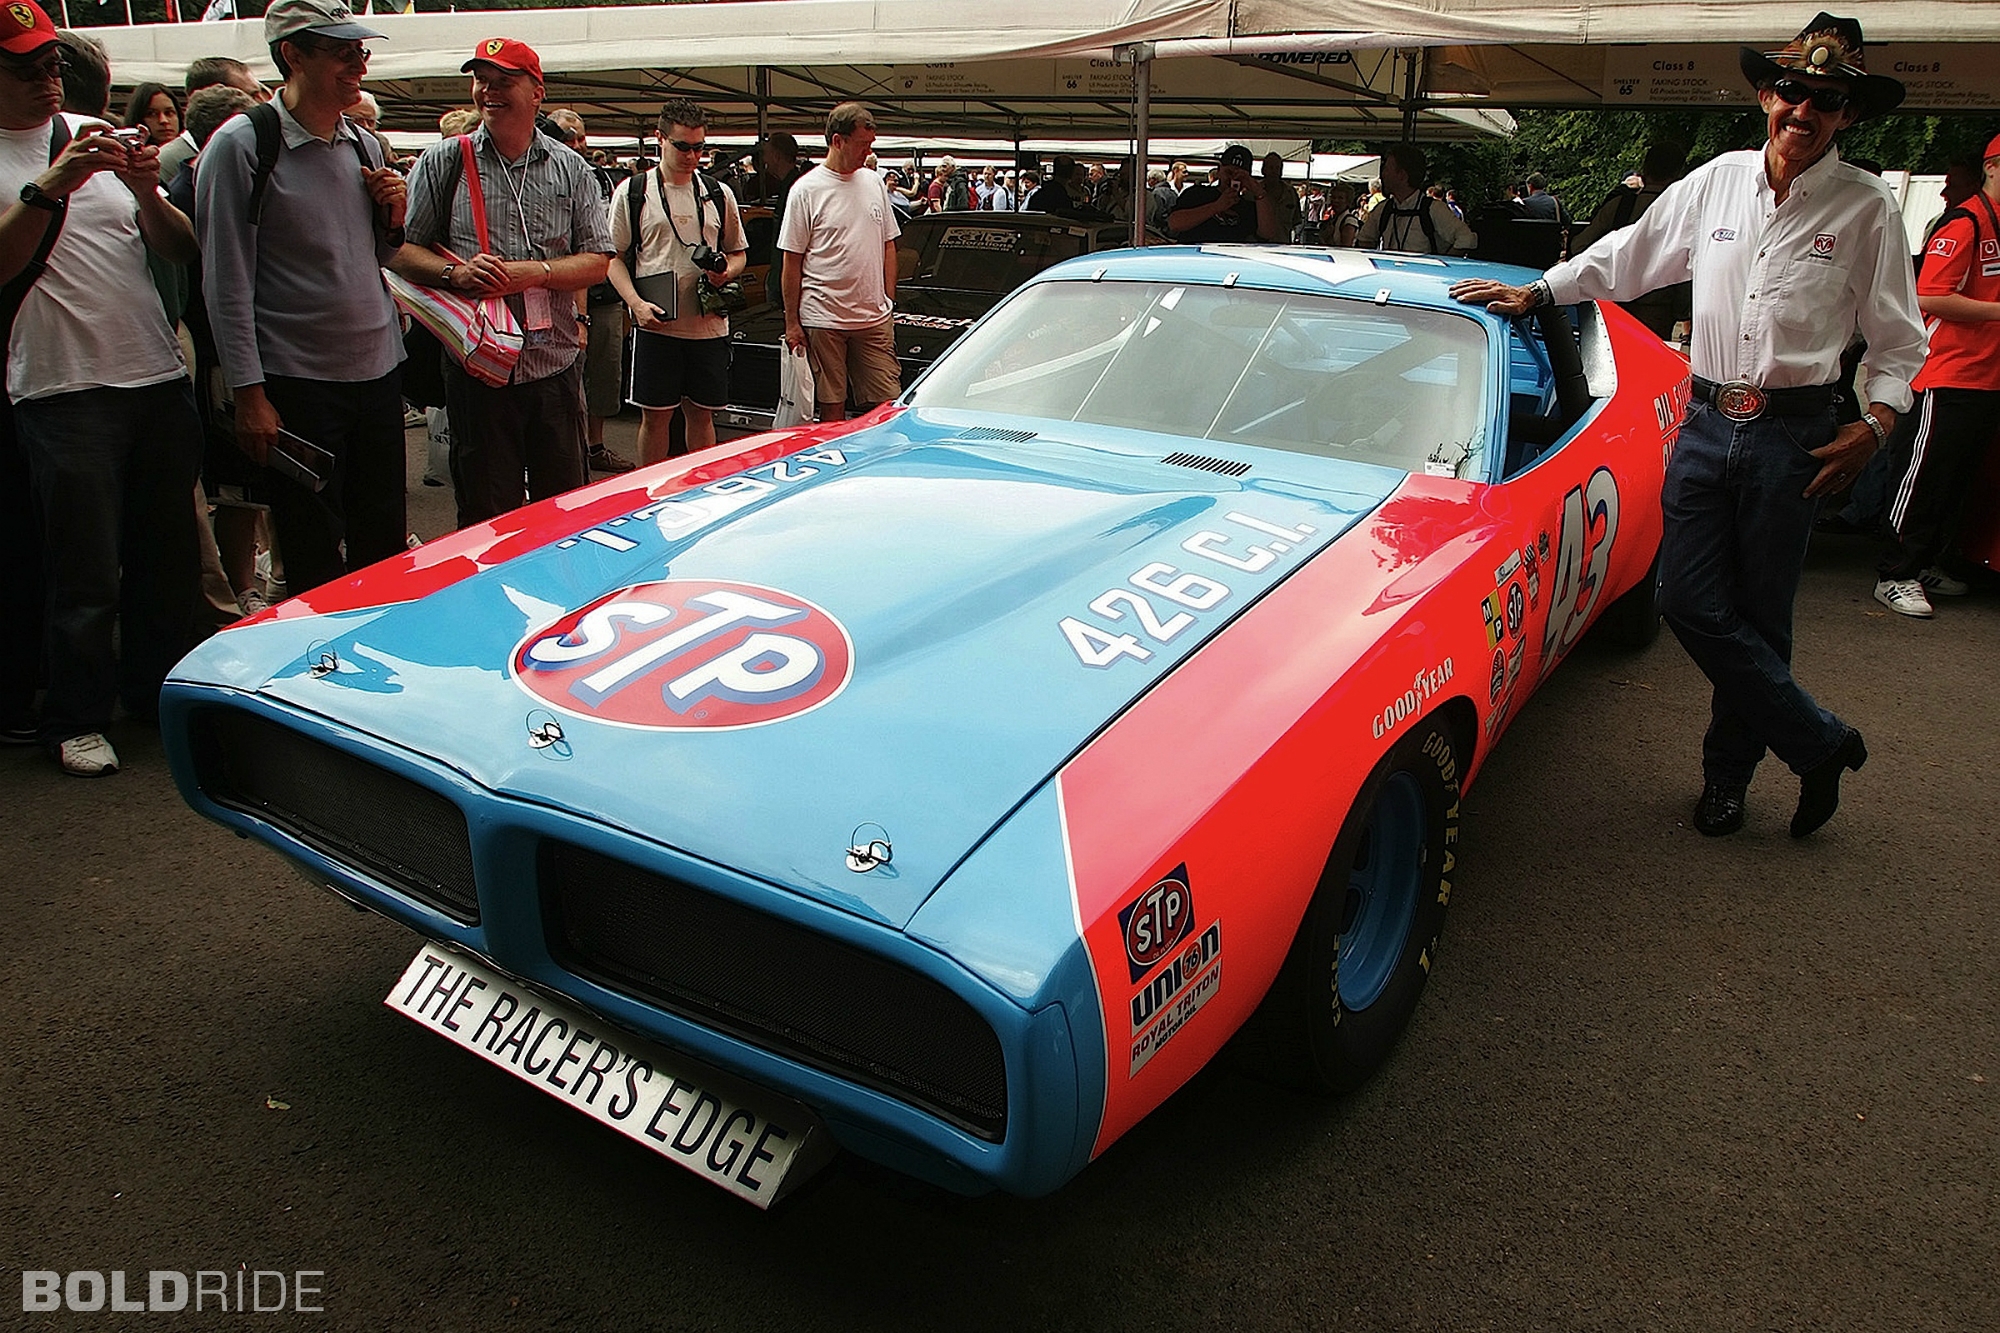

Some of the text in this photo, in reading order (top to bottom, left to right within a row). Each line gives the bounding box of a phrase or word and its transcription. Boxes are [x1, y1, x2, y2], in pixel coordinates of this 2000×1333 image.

[1089, 58, 1114, 68] Class
[1259, 52, 1351, 64] POWERED
[1652, 60, 1695, 71] Class 8
[1894, 61, 1941, 72] Class 8
[904, 80, 914, 89] 67
[1066, 80, 1078, 89] 66
[1619, 85, 1634, 95] 65
[1651, 78, 1708, 86] TAKING STOCK
[1925, 81, 1955, 89] STOCK
[1653, 392, 1675, 431] OIL
[1540, 465, 1620, 678] 43
[1057, 510, 1320, 670] 426 C.I.
[1482, 603, 1493, 621] M
[1508, 588, 1524, 630] STP
[1494, 622, 1503, 638] P
[521, 589, 826, 716] STP
[1371, 657, 1454, 740] GOODYEAR
[1421, 731, 1460, 907] GOODYEAR
[1136, 886, 1181, 954] STP
[1131, 965, 1219, 1062] ROYAL TRITON
[1154, 1004, 1198, 1052] MOTOR OIL
[402, 955, 789, 1192] THE RACER'S EDGE
